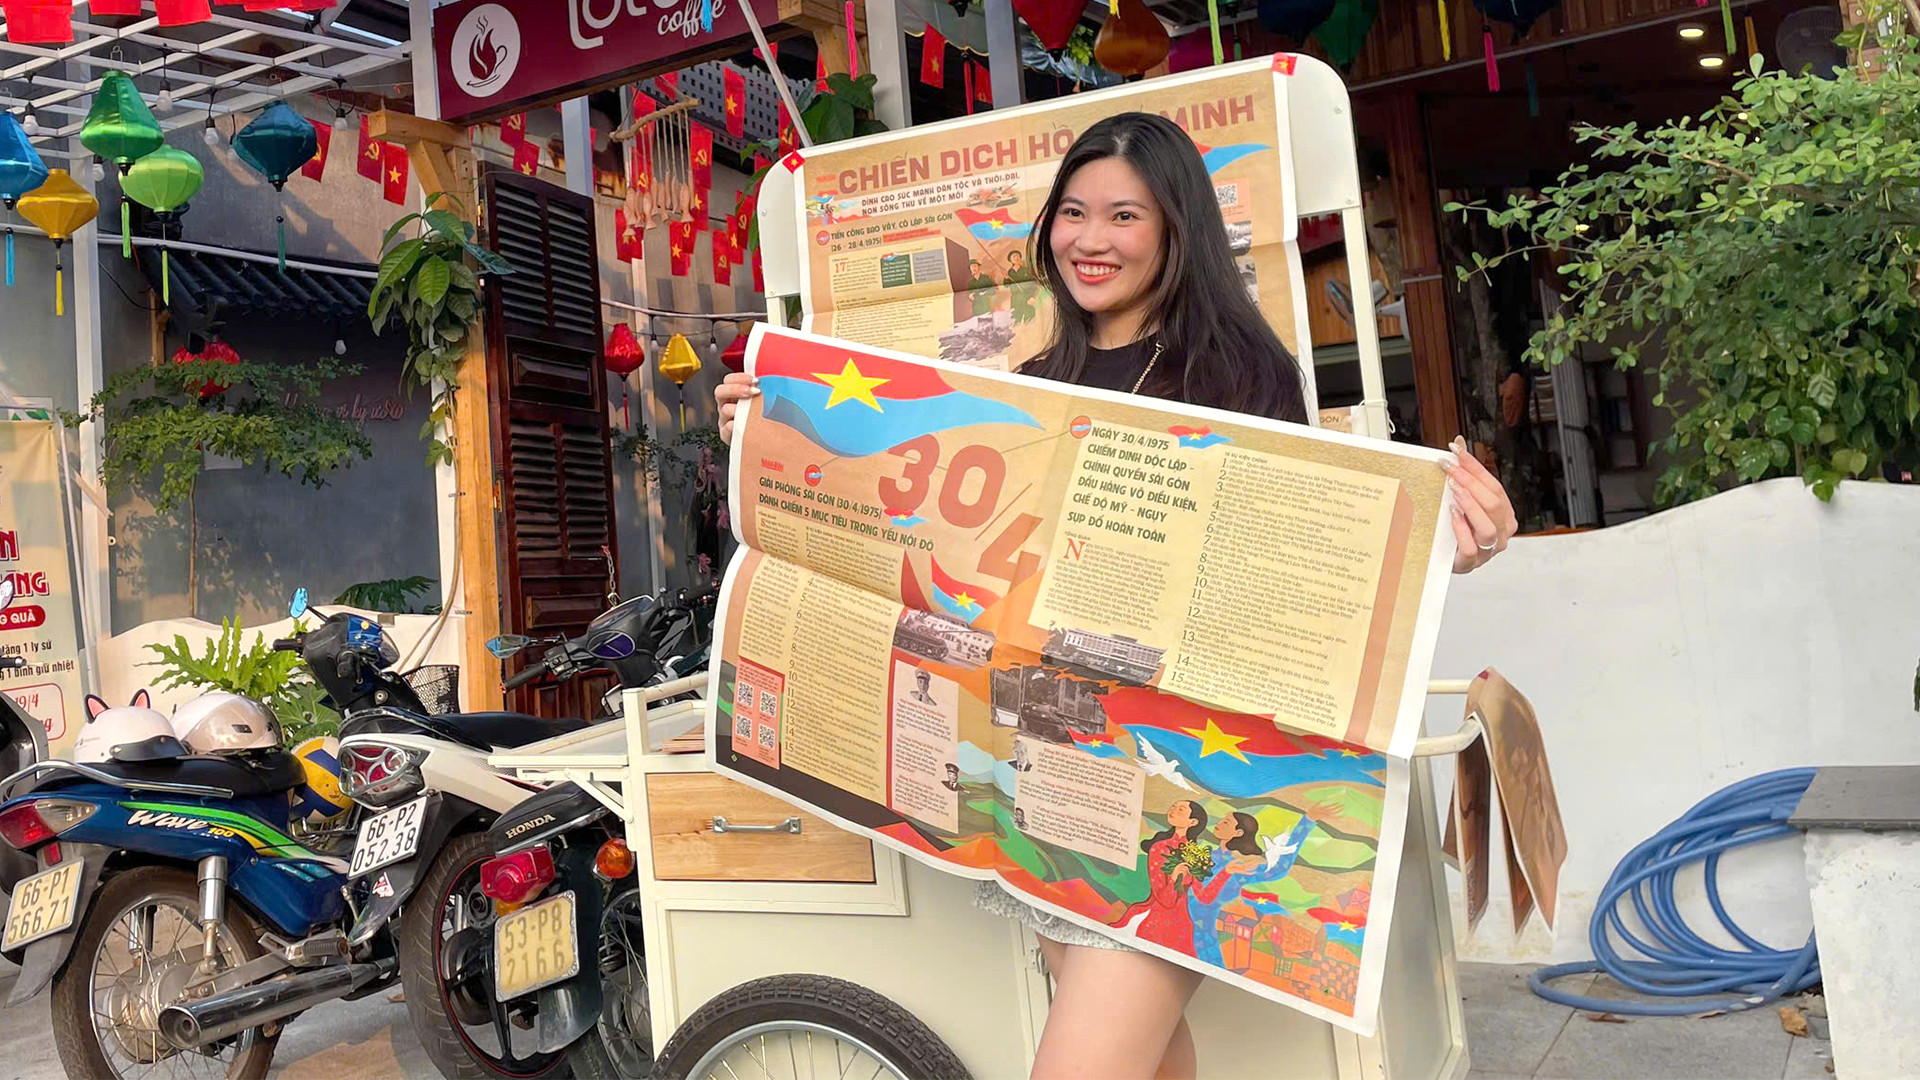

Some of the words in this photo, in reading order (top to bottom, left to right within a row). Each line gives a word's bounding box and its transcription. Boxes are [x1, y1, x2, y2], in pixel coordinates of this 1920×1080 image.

[658, 0, 726, 38] coffe
[838, 151, 930, 194] CHIẾN
[940, 138, 1018, 178] DỊCH
[835, 261, 848, 274] 17
[1091, 426, 1120, 441] NGÀY
[1121, 432, 1170, 451] 30/4/1975
[1118, 449, 1142, 463] DINH
[1222, 458, 1227, 468] 1
[1082, 459, 1110, 475] CHÍNH
[1166, 475, 1190, 491] GÒN
[1219, 470, 1226, 480] 2
[1100, 480, 1126, 496] HÀNG
[1130, 486, 1145, 499] VÔ
[1216, 482, 1223, 492] 3
[1212, 500, 1220, 510] 4
[804, 507, 810, 517] 5
[850, 520, 879, 537] TRONG
[1209, 511, 1217, 521] 5
[1105, 519, 1134, 536] HOÀN
[1137, 526, 1166, 543] TOÀN
[1206, 523, 1214, 533] 6
[1203, 535, 1211, 545] 7
[1200, 552, 1207, 562] 8
[1198, 564, 1205, 575] 9
[1195, 576, 1207, 588] 10
[1192, 588, 1202, 600] 11
[10, 608, 36, 625] QUÀ
[1187, 606, 1201, 618] 12
[1182, 630, 1196, 642] 13
[31, 640, 39, 653] ly
[1177, 653, 1190, 666] 14
[1171, 671, 1185, 683] 15
[127, 809, 209, 830] Wave
[366, 803, 418, 843] 66-P2
[208, 827, 235, 838] 100
[505, 814, 556, 839] HONDA
[352, 828, 415, 873] 052.38
[7, 896, 70, 945] 566.71
[503, 901, 563, 952] 53-P8
[506, 943, 566, 986] 2166
